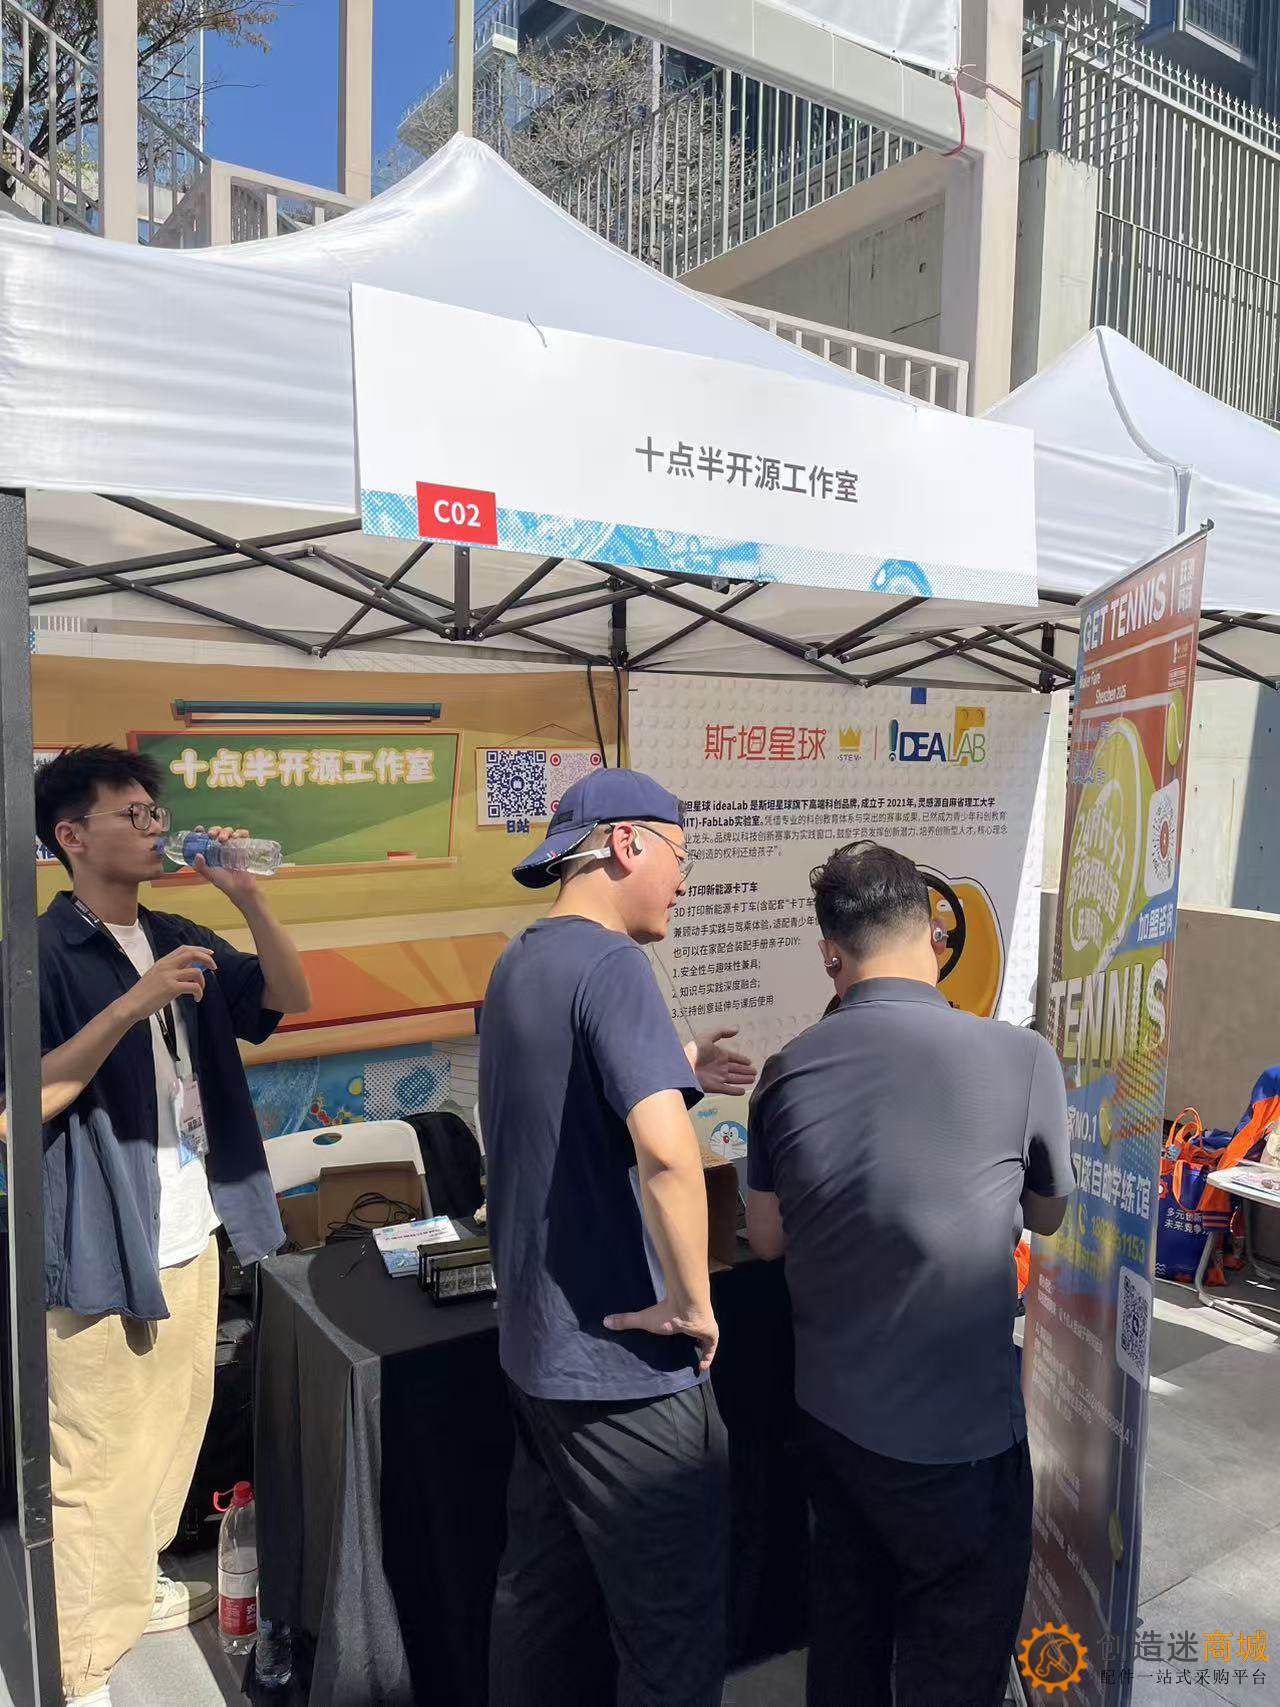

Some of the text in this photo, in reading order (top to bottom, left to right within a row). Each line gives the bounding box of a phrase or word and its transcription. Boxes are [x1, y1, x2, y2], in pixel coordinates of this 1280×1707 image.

[635, 436, 859, 503] 十点半开源工作室
[433, 499, 481, 528] C02
[1083, 604, 1108, 653] GET
[1110, 572, 1166, 641] TENNIS
[704, 723, 827, 761] 斯坦星球
[169, 748, 435, 789] 十点半开源工作室
[713, 800, 748, 811] ideaLab
[673, 907, 685, 918] 3D
[673, 916, 819, 939] 兼顾动手实践与驾乘体验,适配青少年
[1050, 958, 1168, 1063] TENNIS
